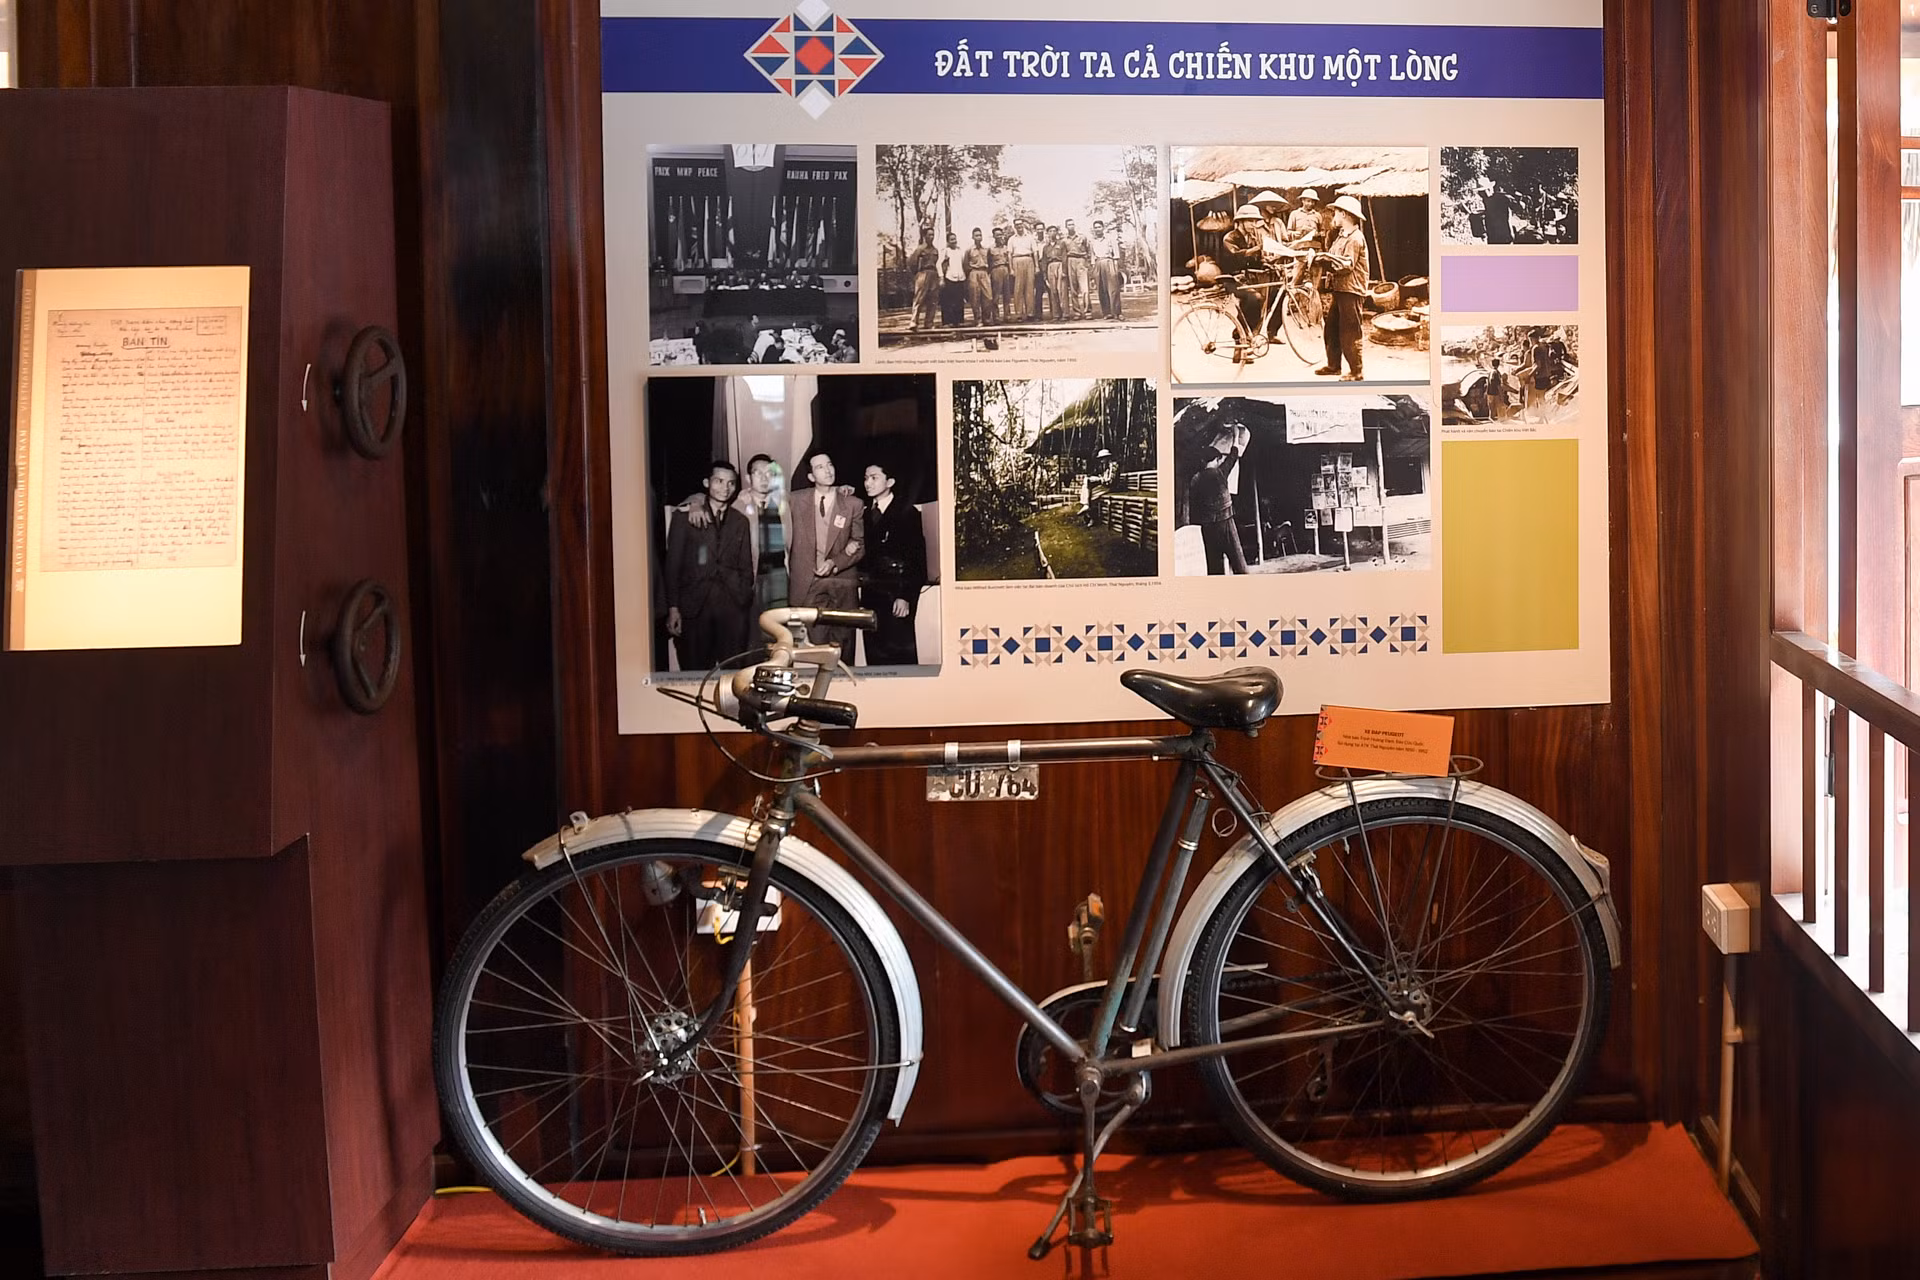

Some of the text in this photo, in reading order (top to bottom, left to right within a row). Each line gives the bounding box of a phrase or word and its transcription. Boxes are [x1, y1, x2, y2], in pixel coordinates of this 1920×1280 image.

[935, 38, 1459, 88] ĐẤT TRỜI TA CẢ CHIẾN KHU MỘT LÒNG
